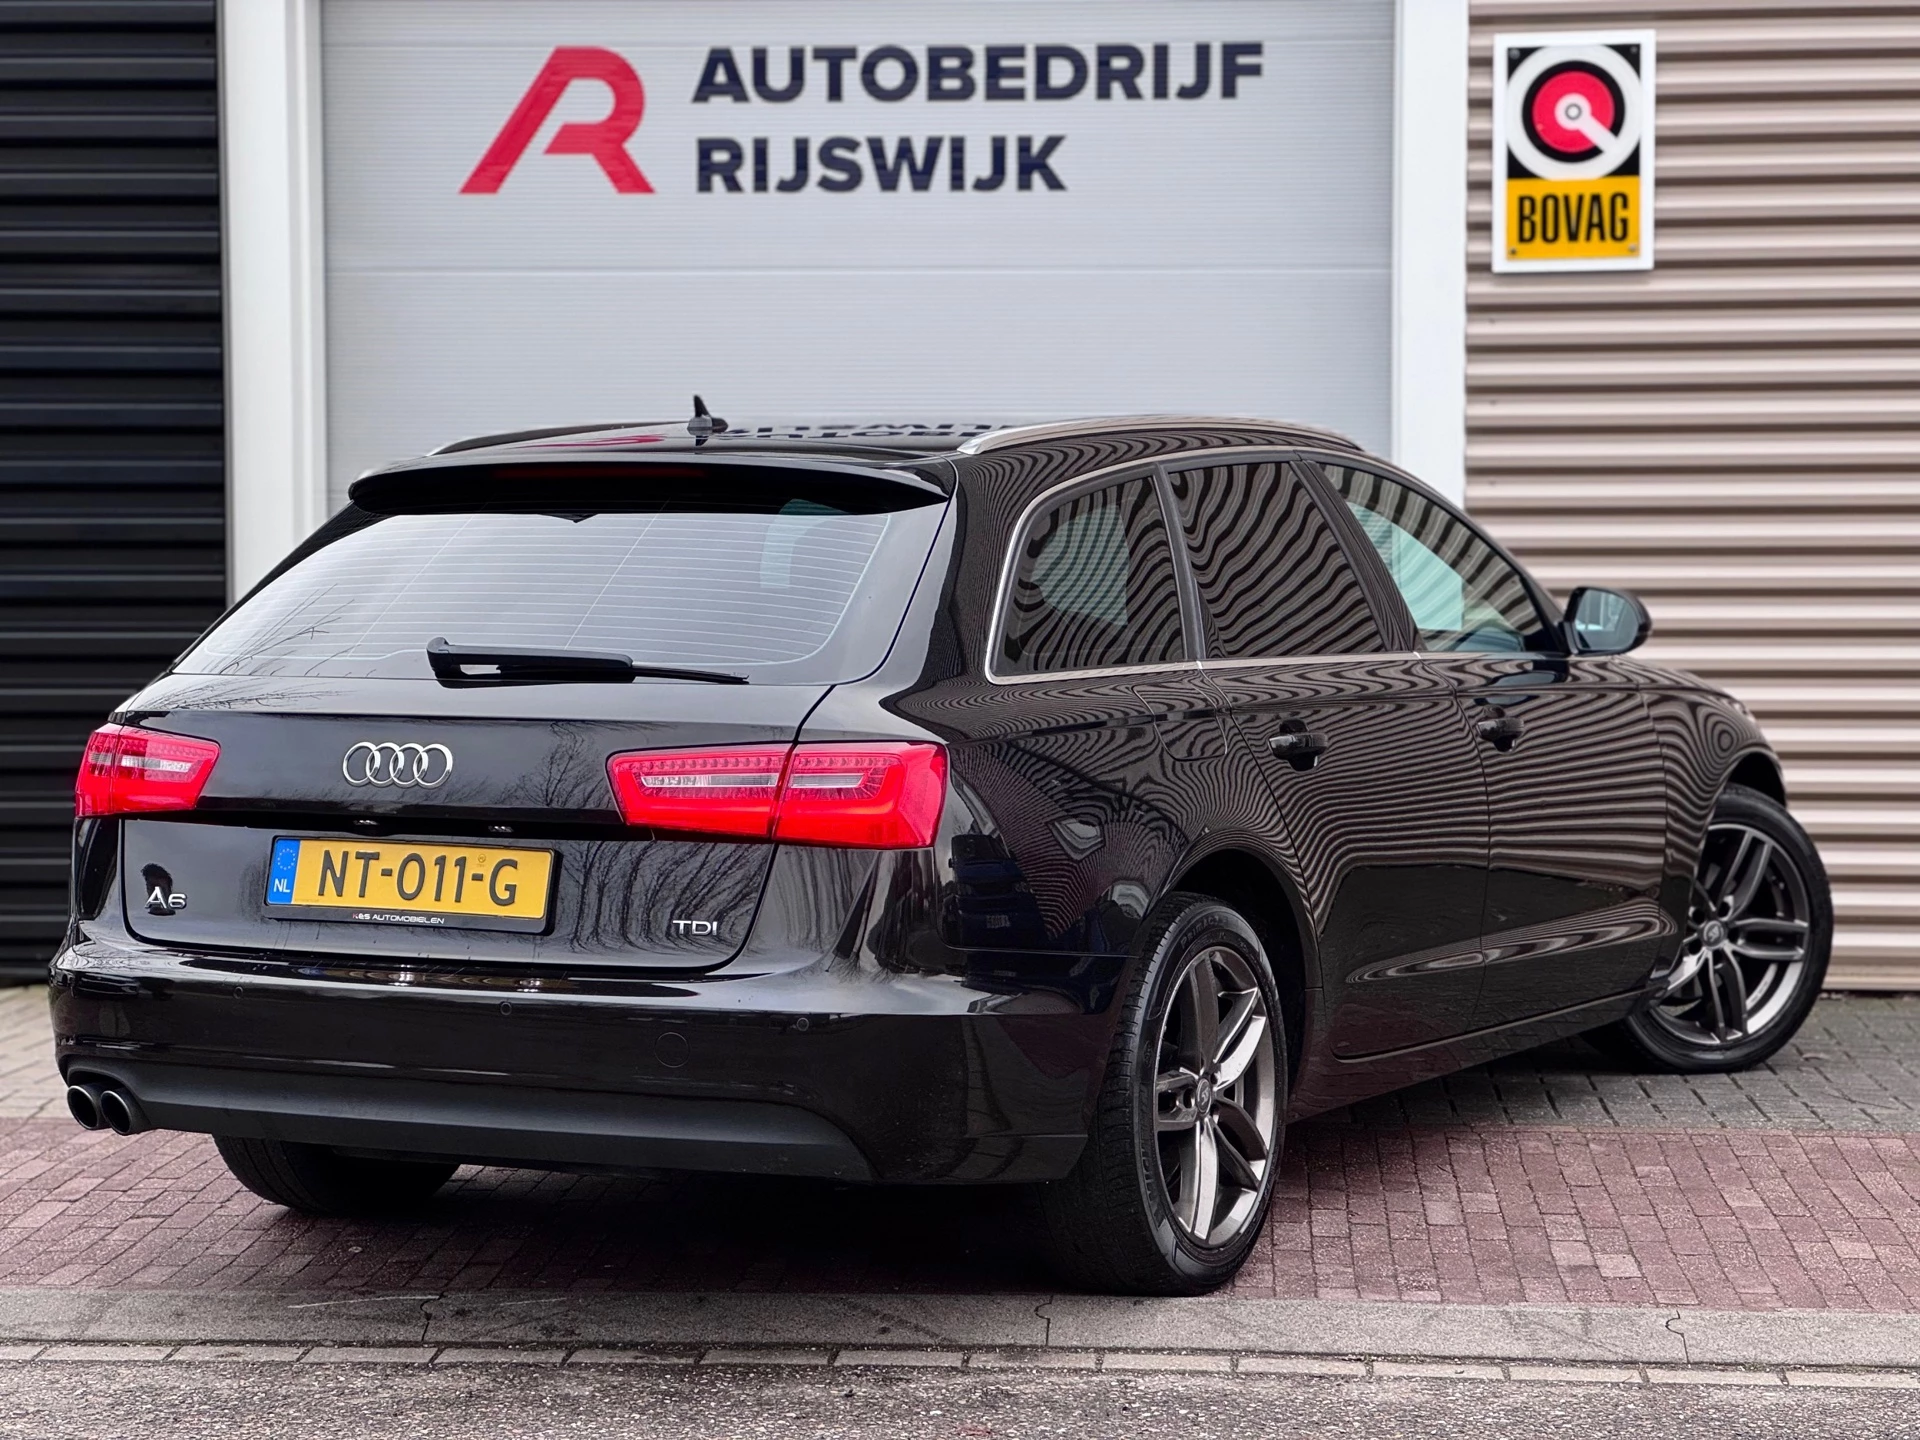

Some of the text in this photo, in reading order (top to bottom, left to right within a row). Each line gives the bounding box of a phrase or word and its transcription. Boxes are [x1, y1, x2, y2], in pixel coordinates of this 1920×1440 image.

[692, 42, 1263, 103] AUTOBEDRIJF
[696, 135, 1067, 194] RIJSWIJK
[1517, 191, 1629, 244] BOVAG
[144, 885, 187, 909] A6
[273, 877, 291, 893] NL
[317, 849, 518, 907] NT-011-G
[371, 913, 445, 924] AUTOMOBIELEN
[672, 919, 718, 936] TDI
